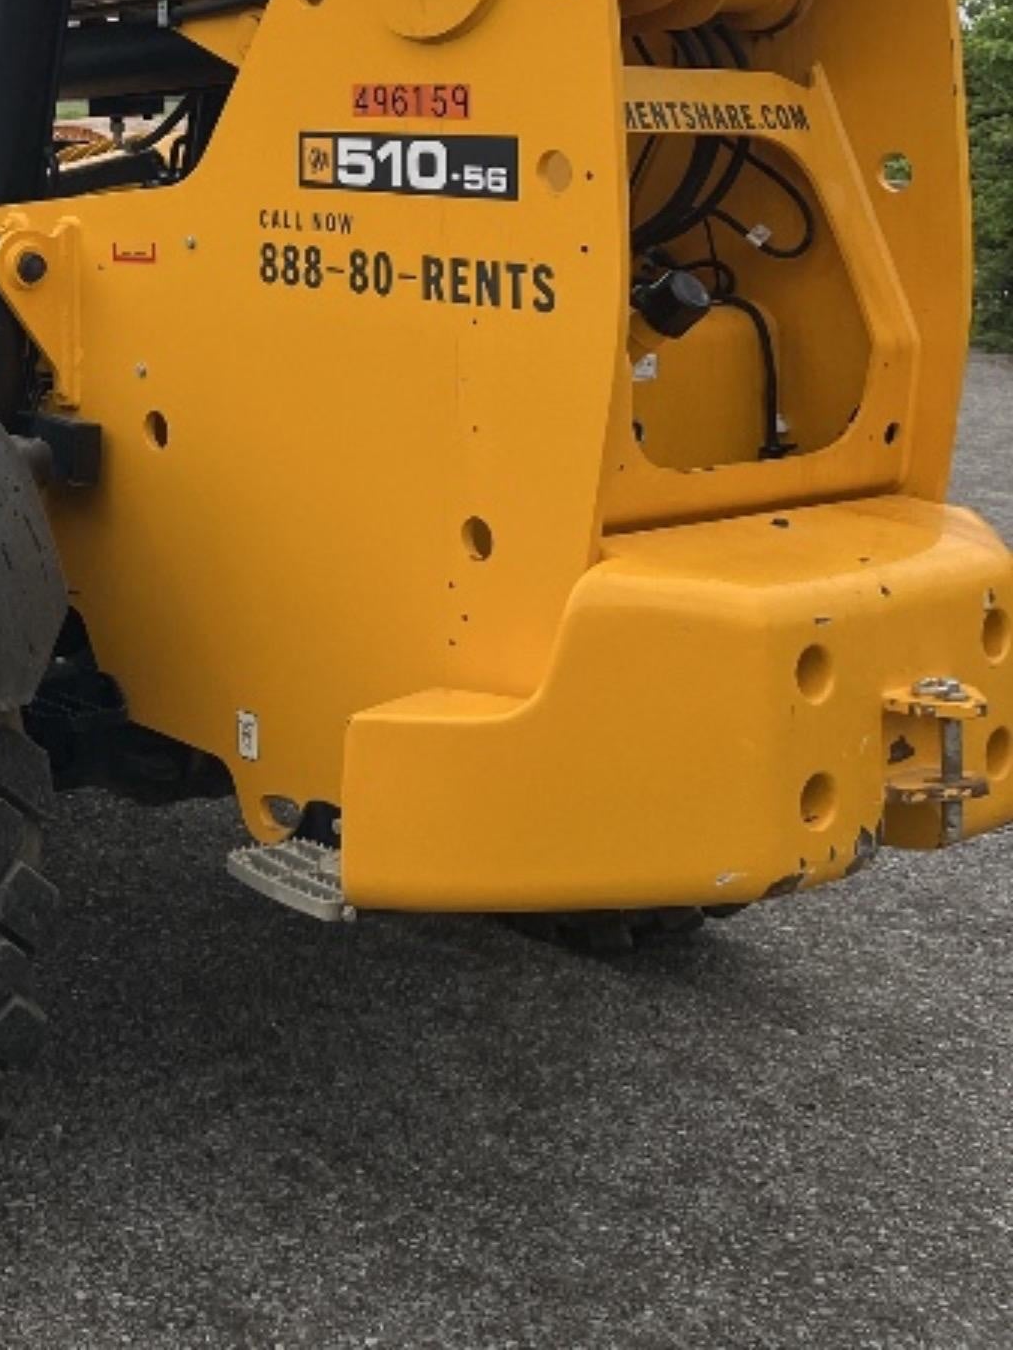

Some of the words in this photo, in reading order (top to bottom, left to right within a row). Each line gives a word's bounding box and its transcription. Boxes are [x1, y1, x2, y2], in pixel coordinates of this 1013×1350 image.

[353, 84, 469, 118] 496159
[259, 209, 303, 231] CALL
[311, 212, 354, 234] NOW
[259, 242, 556, 313] 888-80-RENTS
